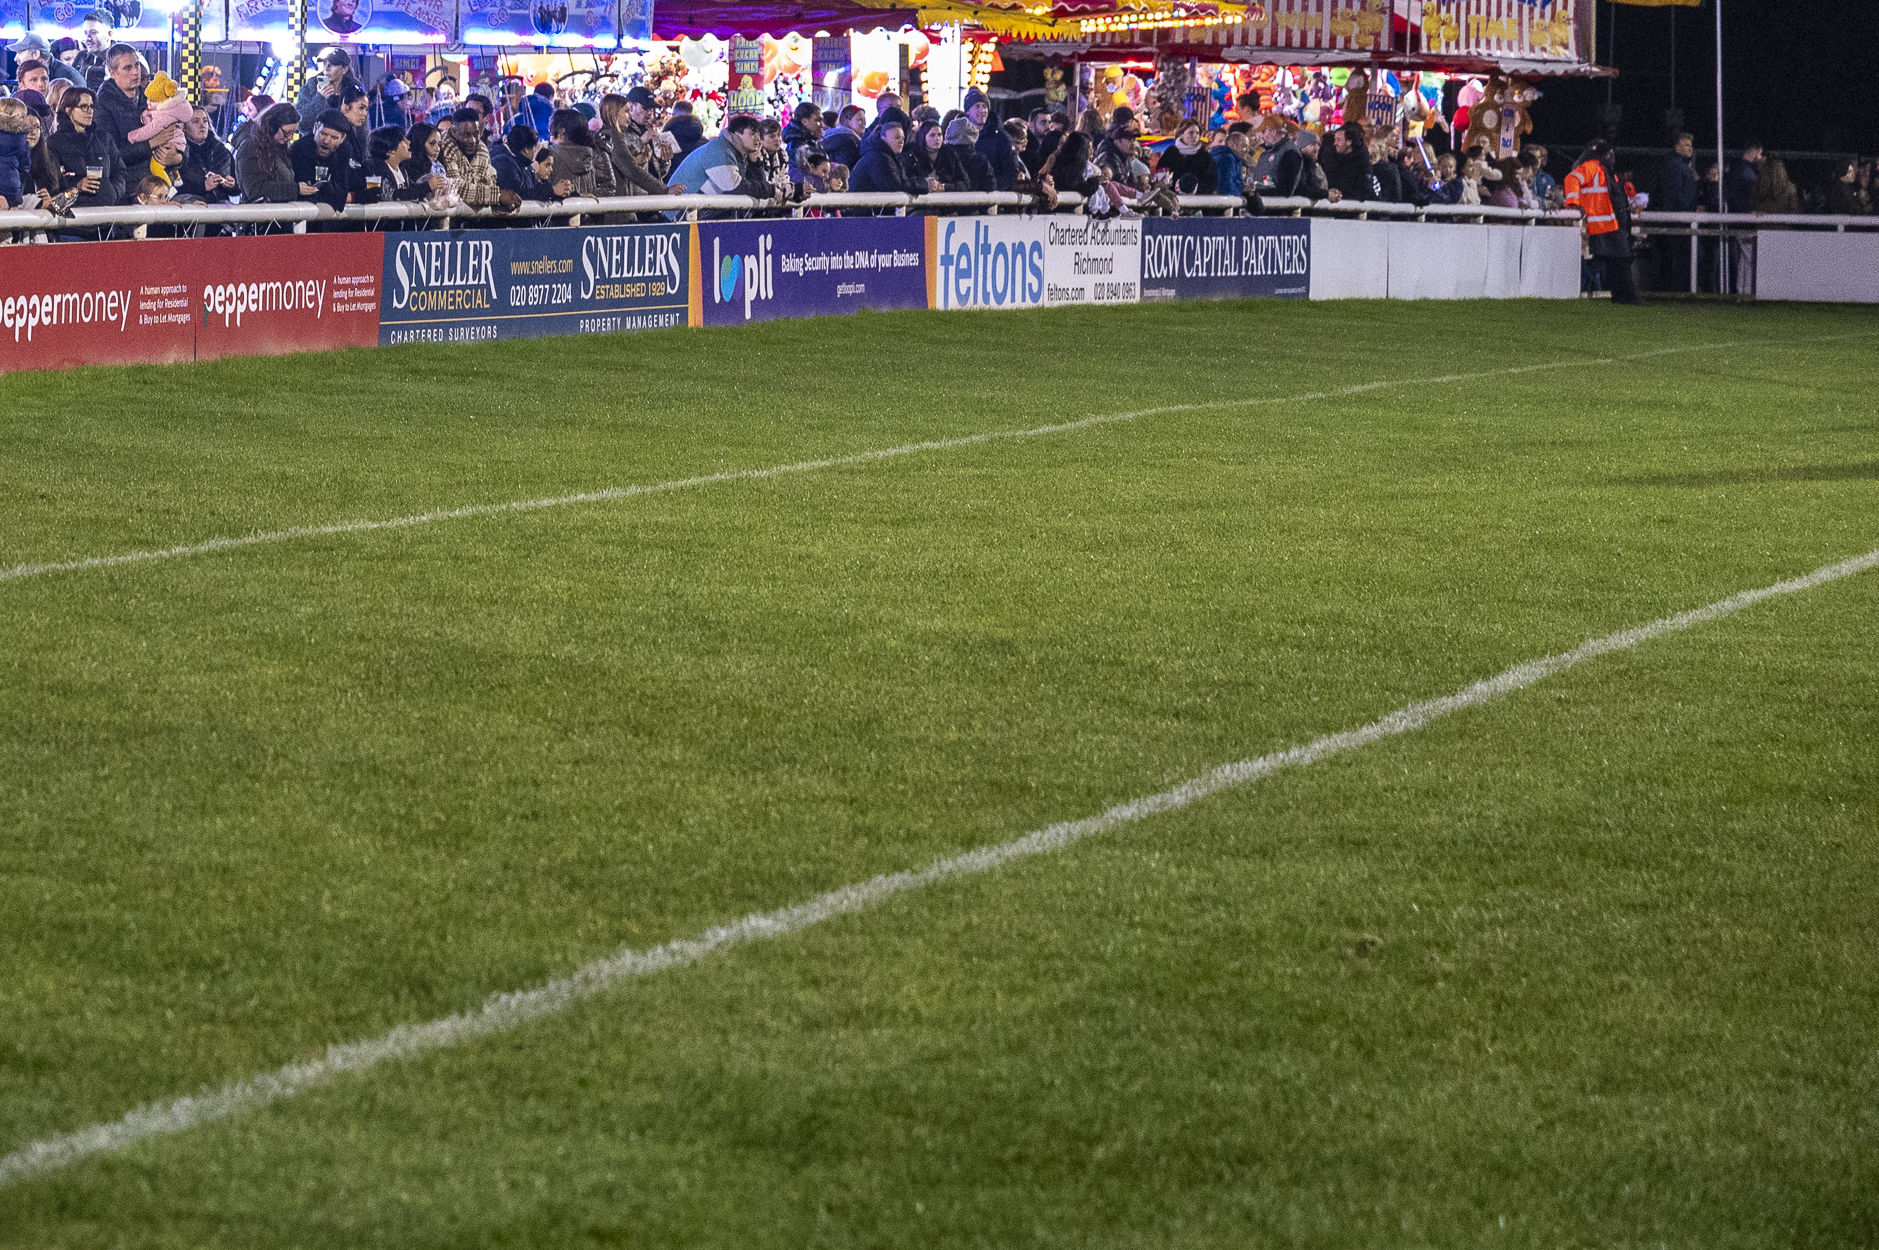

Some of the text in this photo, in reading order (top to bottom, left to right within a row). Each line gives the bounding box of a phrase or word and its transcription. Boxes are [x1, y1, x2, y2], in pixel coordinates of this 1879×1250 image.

[54, 1, 76, 23] GO
[487, 7, 510, 28] GO
[1275, 11, 1322, 31] WIN
[1467, 14, 1519, 40] TIME
[730, 91, 763, 111] HOOK
[1048, 221, 1138, 246] Chartered Accountants
[510, 255, 573, 276] www.snellers.com
[580, 232, 681, 300] SNELLERS
[781, 248, 919, 277] Baking Security into the DNA of your Business
[940, 220, 1043, 309] feltons
[1073, 252, 1114, 275] Richmond
[1183, 235, 1239, 278] CAPITAL
[1241, 234, 1308, 276] PARTNERS
[392, 239, 498, 309] SNELLER
[144, 285, 160, 295] human
[161, 283, 182, 297] approach
[182, 284, 188, 293] to
[409, 288, 490, 312] COMMERCIAL
[510, 282, 572, 307] 020 8977 2204
[595, 281, 666, 300] ESTABLISHED 1929
[1047, 283, 1085, 301] feltons.com
[1093, 282, 1105, 300] 020
[1105, 281, 1121, 300] 8940
[1121, 281, 1136, 299] 0963
[139, 299, 156, 311] lending
[164, 297, 189, 309] Residential
[203, 278, 327, 329] peppermoney
[143, 314, 153, 326] Buy
[153, 315, 159, 324] to
[159, 313, 167, 323] Let
[167, 312, 191, 325] Mortgages
[579, 313, 680, 333] PROPERTY MANAGEMENT
[390, 325, 498, 345] CHARTERED SURVEYORS
